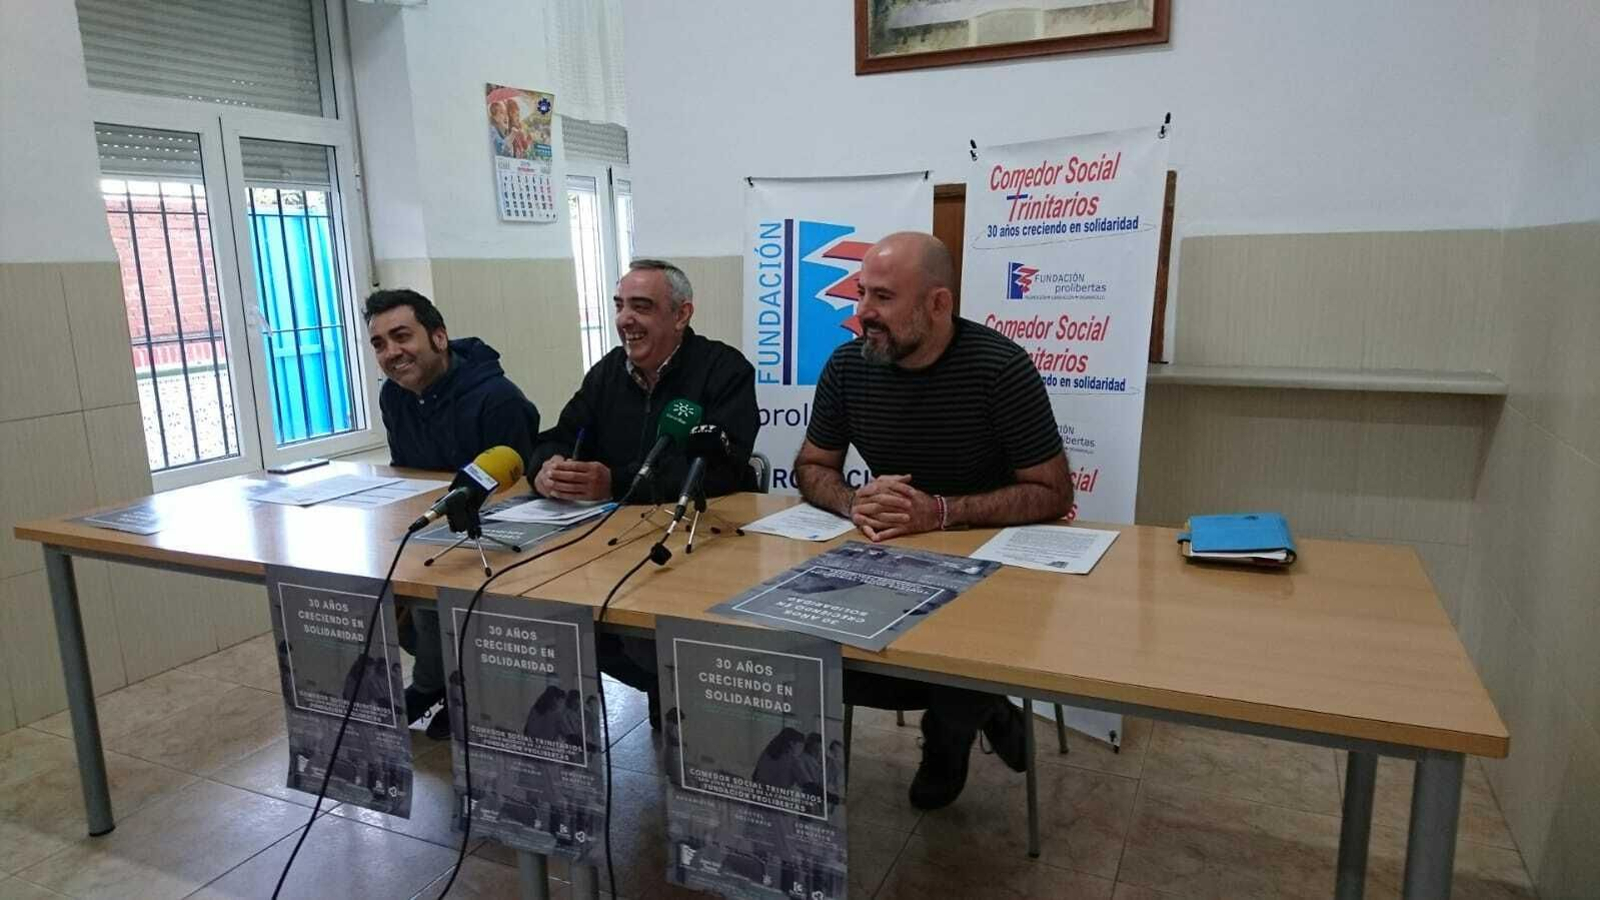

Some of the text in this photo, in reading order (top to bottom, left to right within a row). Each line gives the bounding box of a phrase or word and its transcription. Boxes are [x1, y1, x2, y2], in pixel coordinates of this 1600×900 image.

[990, 152, 1121, 191] Comedor Social
[1006, 191, 1099, 222] Trinitarios
[987, 215, 1139, 238] 30 años creciendo en solidaridad
[1035, 272, 1085, 283] FUNDACIÓN
[1055, 283, 1107, 294] prolibertas
[754, 222, 782, 385] FUNDACIÓN
[1055, 315, 1110, 341] Social
[1060, 376, 1071, 387] en
[1074, 375, 1126, 391] solidaridad
[298, 610, 350, 626] CRECIENDO
[304, 624, 364, 642] SOLIDARIDAD
[488, 625, 537, 641] 30 AÑOS
[475, 638, 555, 658] CRECIENDO EN
[481, 653, 554, 673] SOLIDARIDAD
[716, 658, 773, 676] 30 AÑOS
[699, 672, 793, 696] CRECIENDO EN
[705, 689, 791, 713] SOLIDARIDAD
[689, 768, 821, 803] COMEDOR SOCIAL TRINITARIOS
